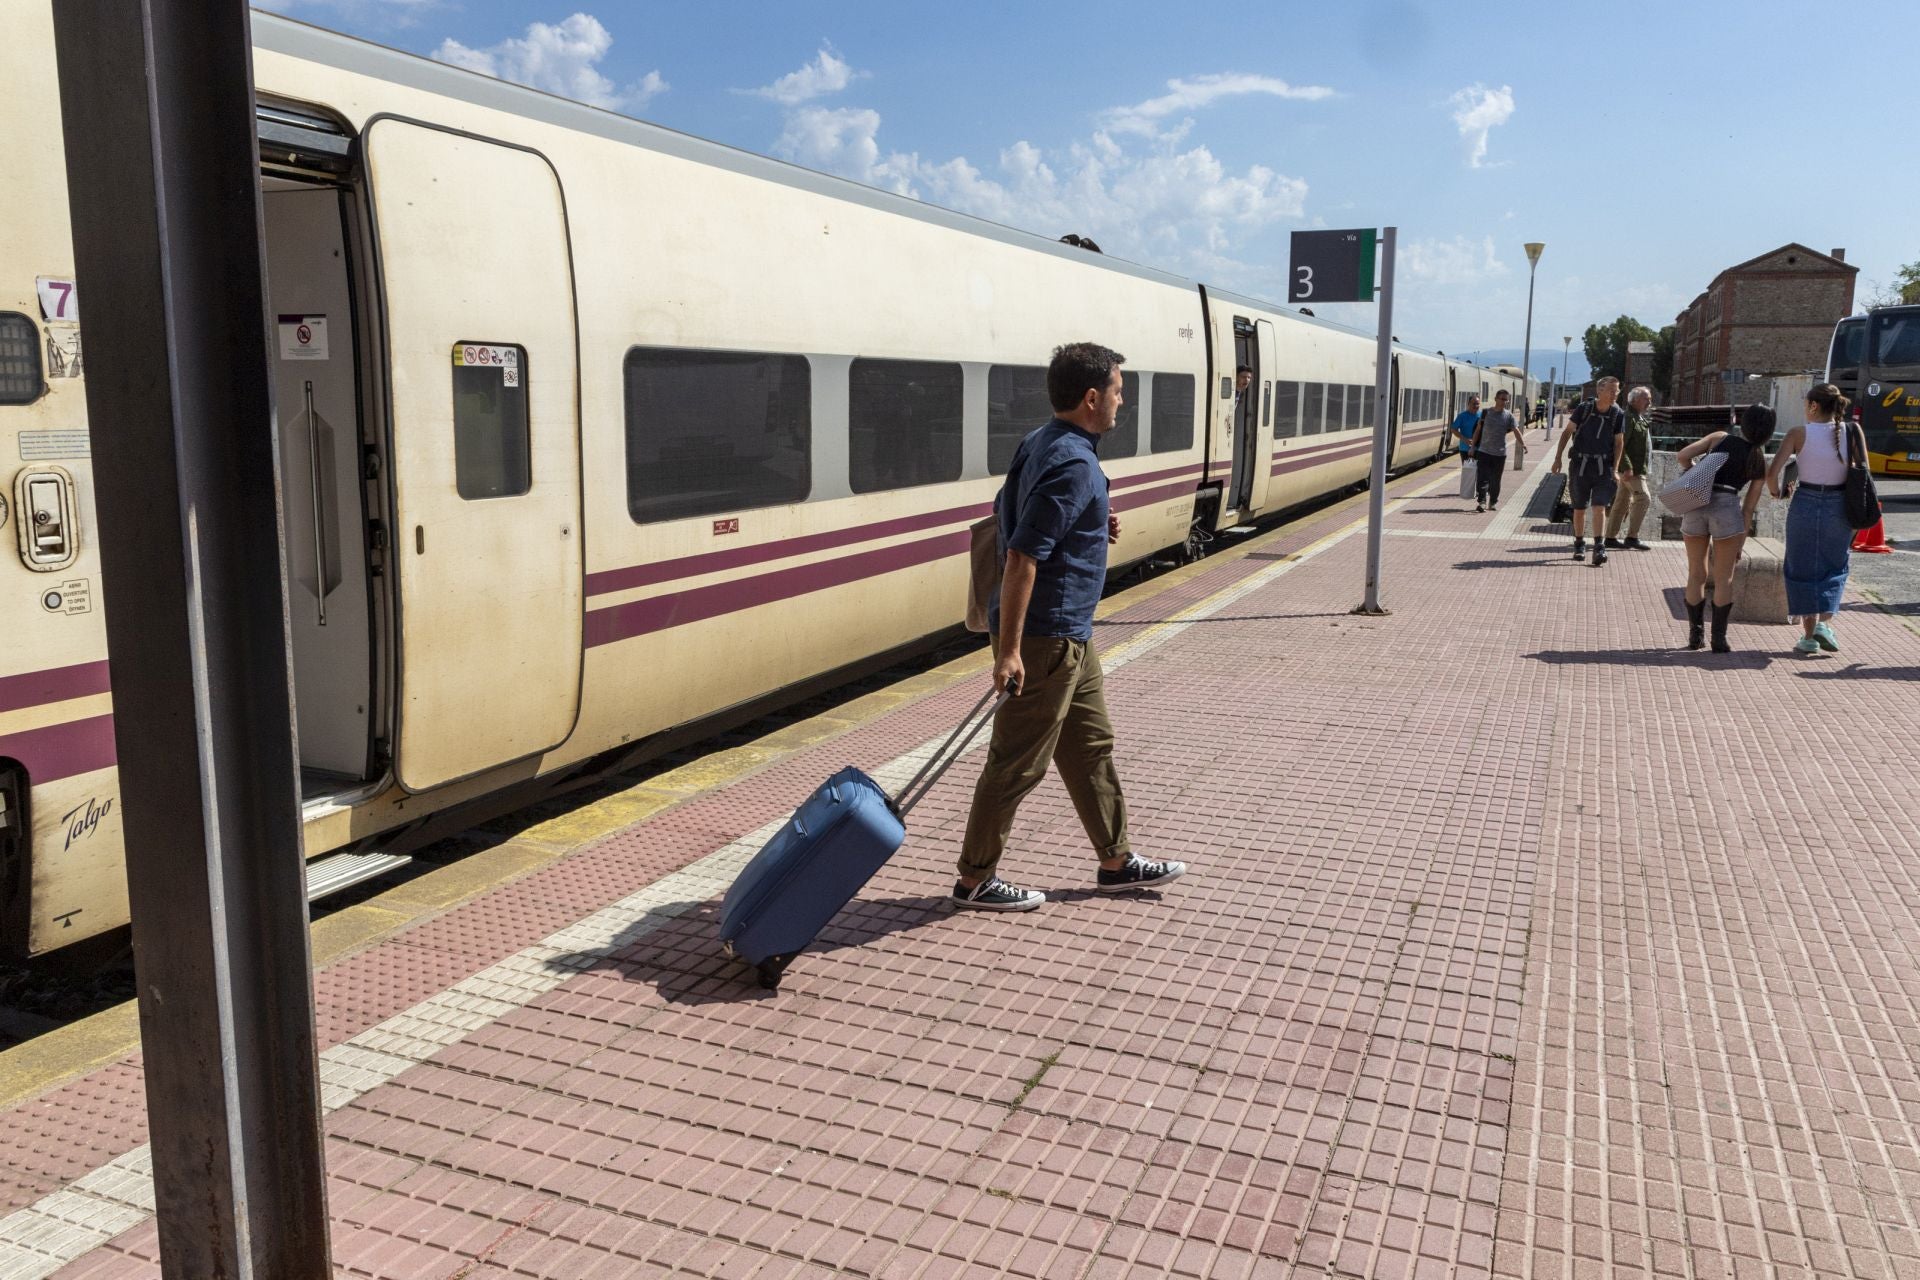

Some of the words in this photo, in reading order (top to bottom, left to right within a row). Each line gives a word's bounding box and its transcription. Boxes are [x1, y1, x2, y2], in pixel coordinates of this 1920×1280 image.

[1296, 265, 1314, 298] 3
[48, 281, 72, 318] 7
[1178, 322, 1194, 344] renfe
[61, 797, 114, 852] Talgo
